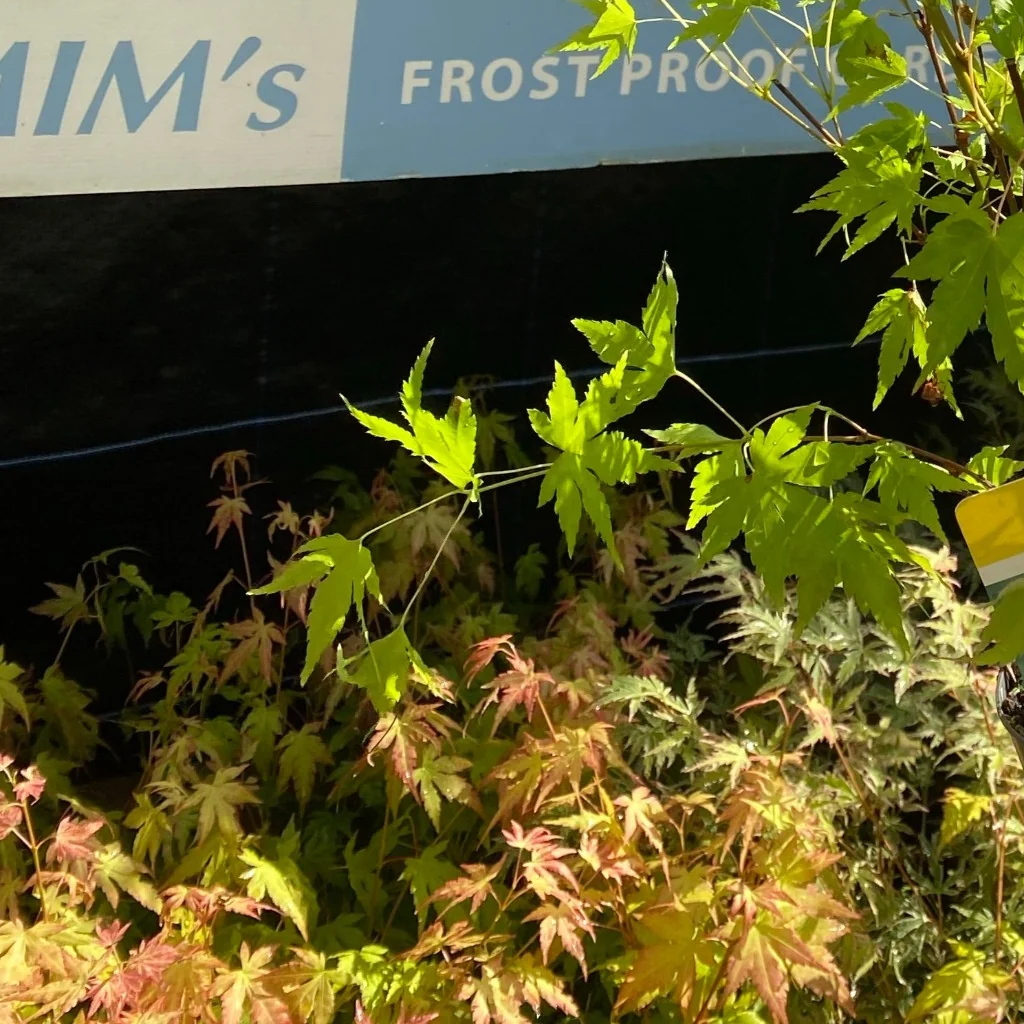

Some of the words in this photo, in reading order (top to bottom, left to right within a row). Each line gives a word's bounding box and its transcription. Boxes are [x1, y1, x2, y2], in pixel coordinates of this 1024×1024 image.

[0, 36, 306, 137] IM's
[401, 55, 601, 105] FROST
[620, 47, 808, 97] PROOF
